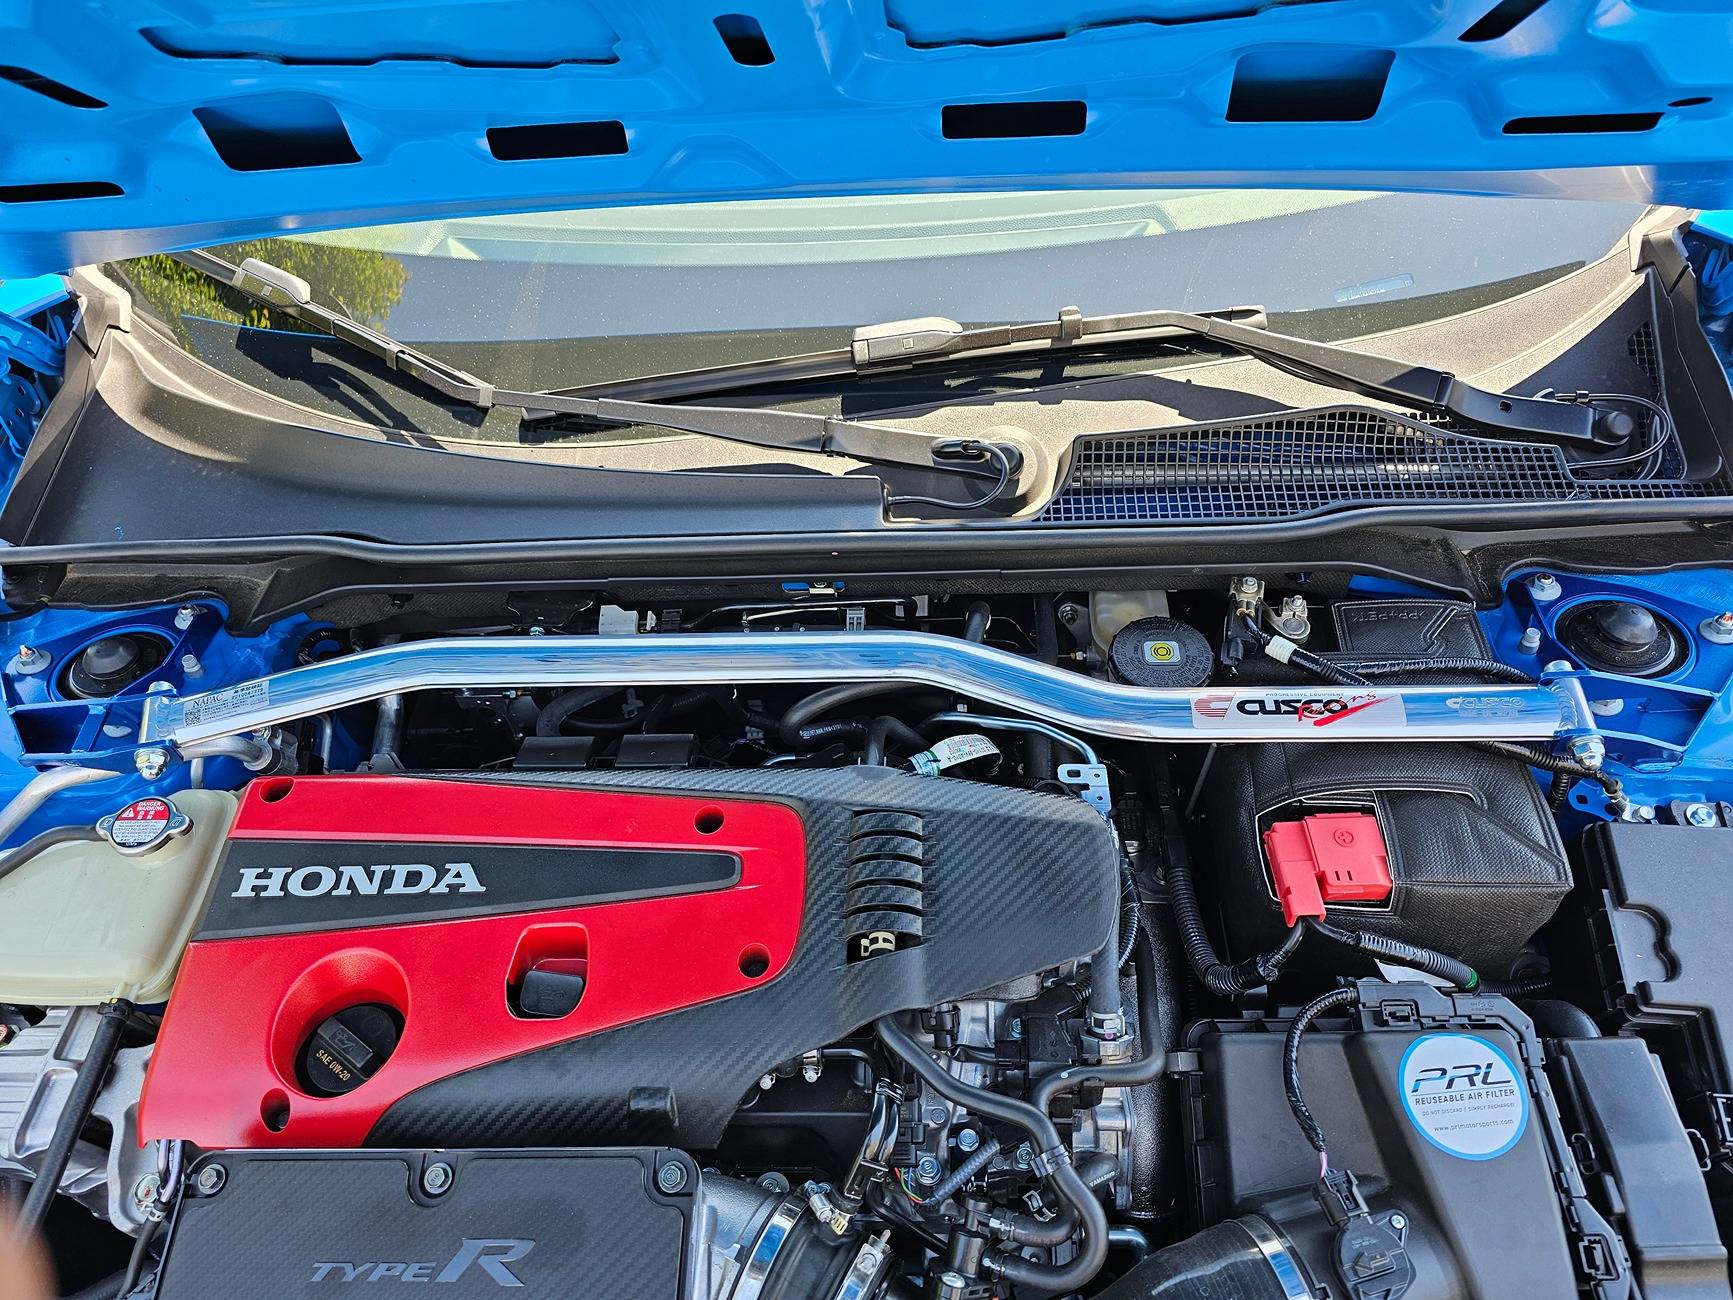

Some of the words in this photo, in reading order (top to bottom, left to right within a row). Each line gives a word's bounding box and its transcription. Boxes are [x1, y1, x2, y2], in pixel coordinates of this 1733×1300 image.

[193, 694, 223, 708] NAPAC
[231, 862, 487, 898] HONDA
[316, 1049, 333, 1066] SAE
[1411, 1062, 1511, 1093] PRL
[1415, 1096, 1465, 1106] REUSEABLE
[1468, 1093, 1484, 1101] AIR
[1486, 1089, 1515, 1098] FILTER
[309, 1261, 437, 1282] TYPE
[435, 1238, 536, 1287] R
